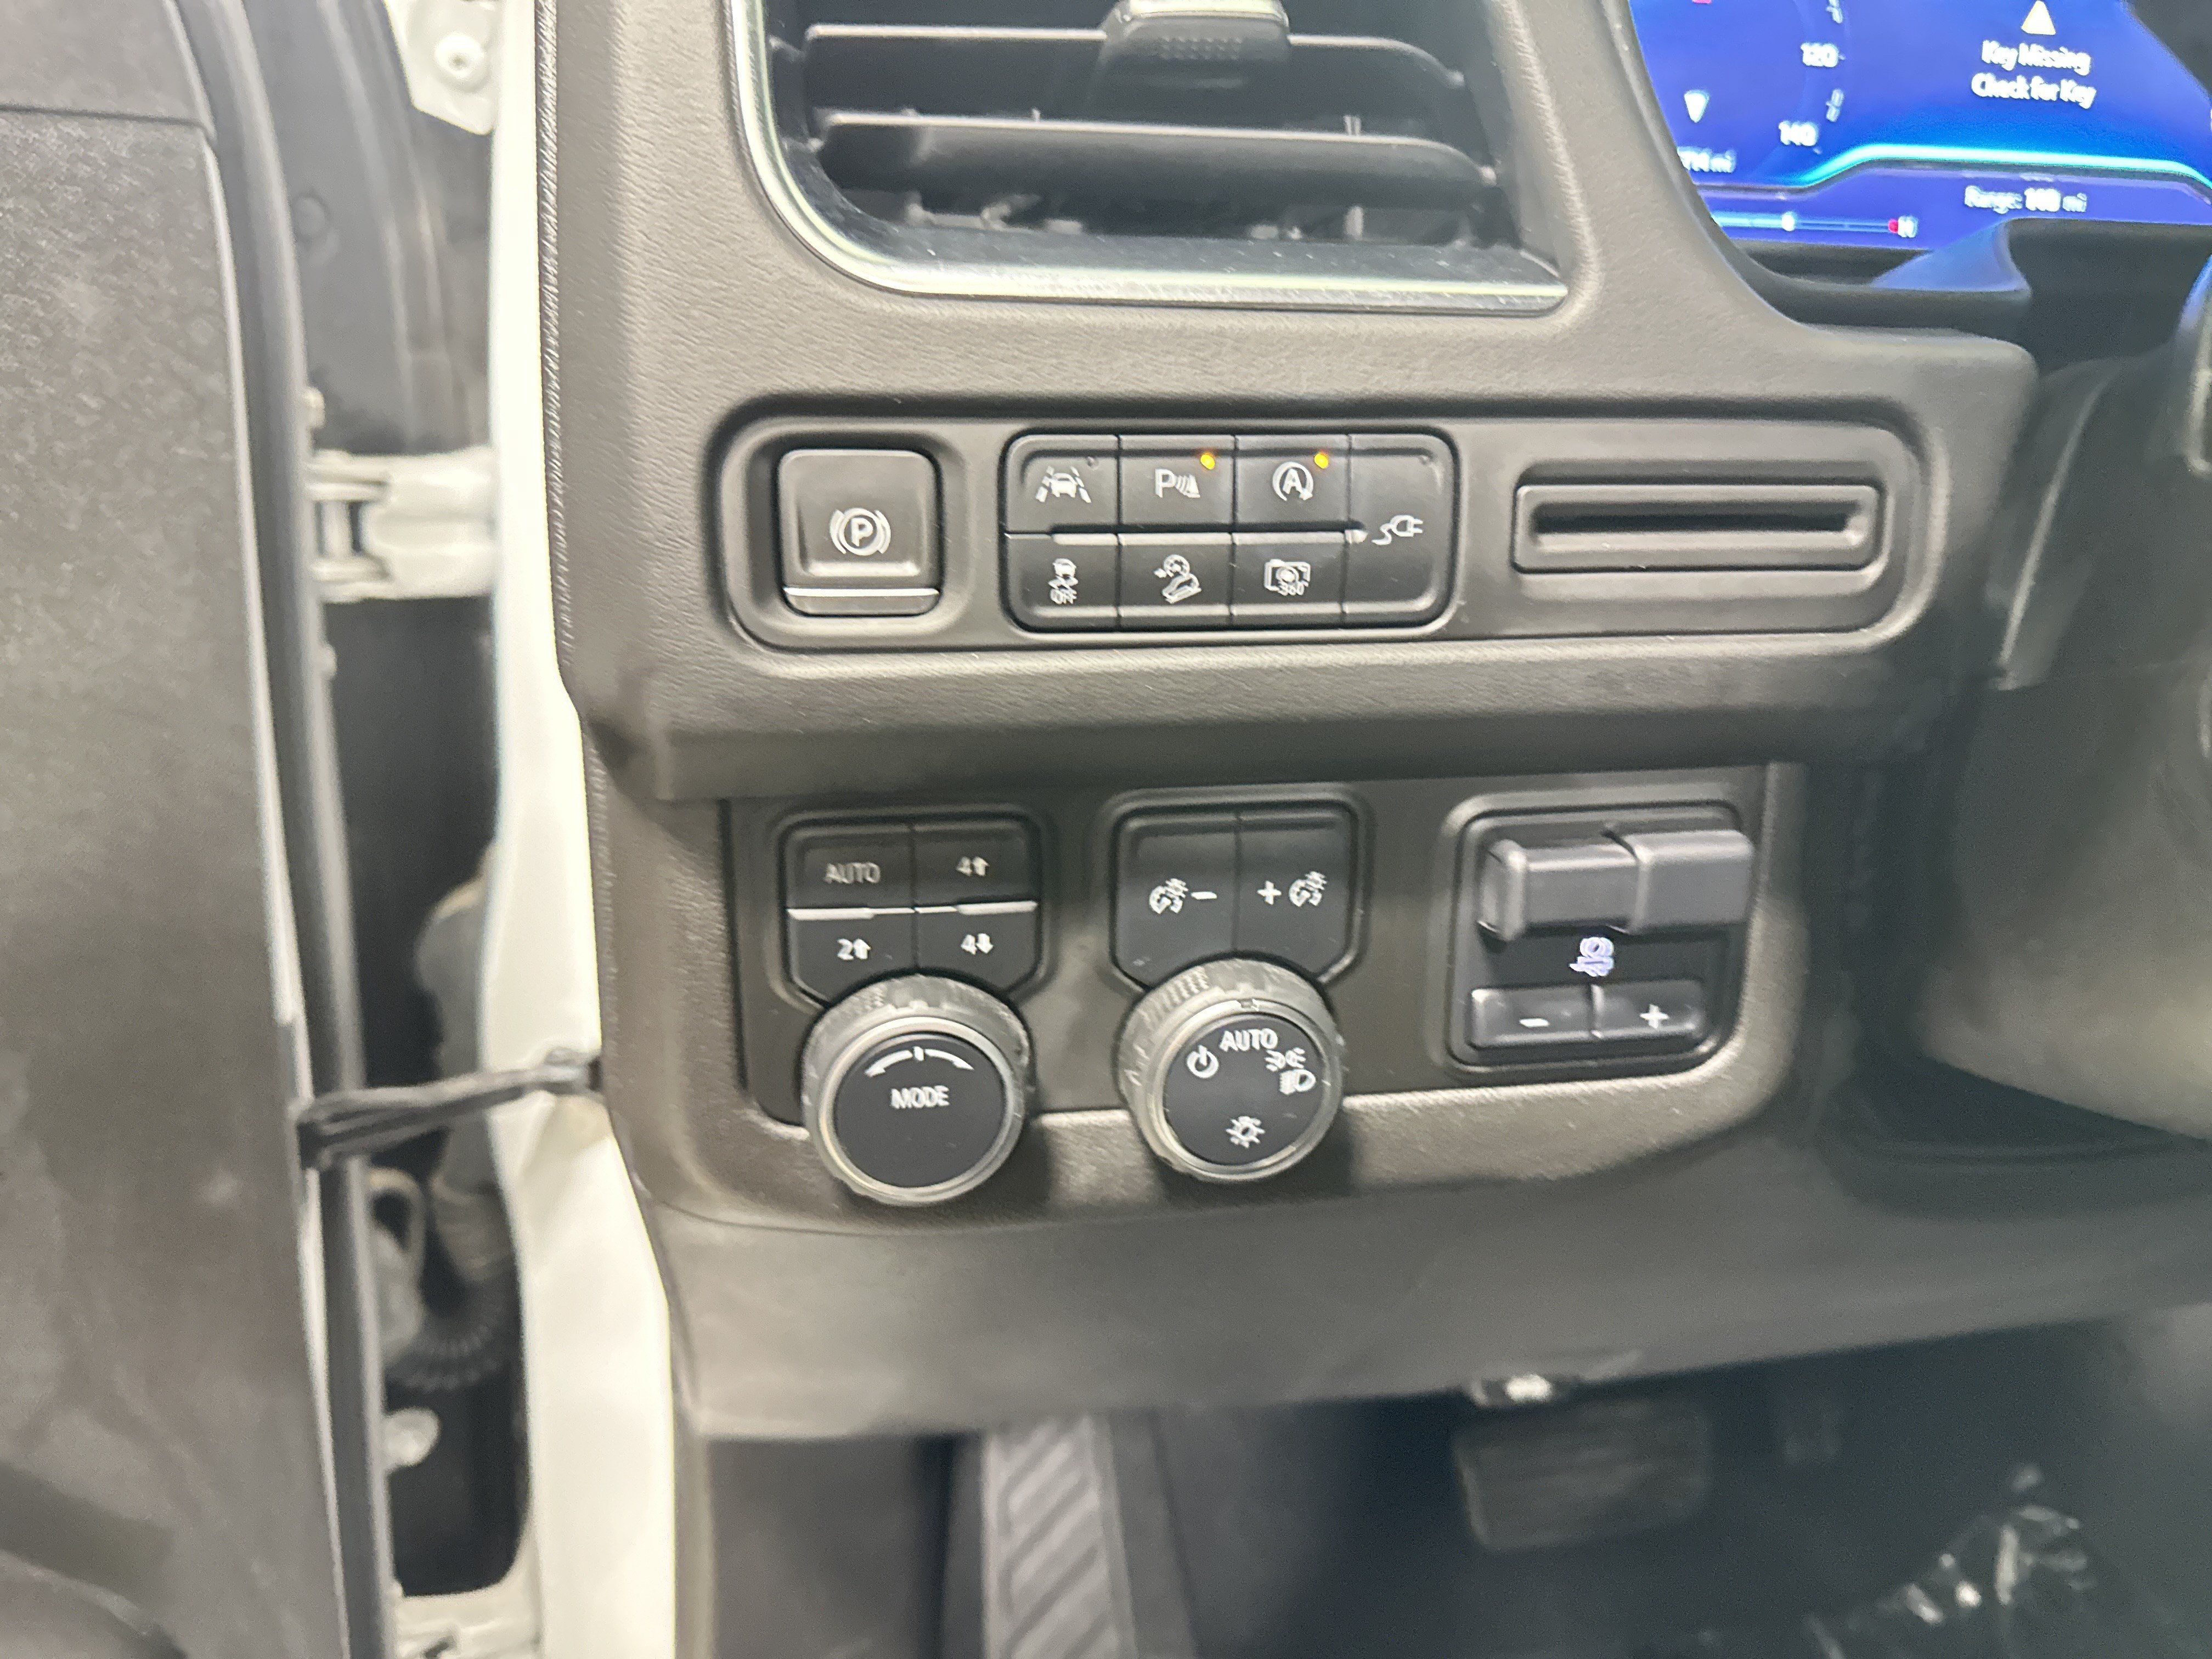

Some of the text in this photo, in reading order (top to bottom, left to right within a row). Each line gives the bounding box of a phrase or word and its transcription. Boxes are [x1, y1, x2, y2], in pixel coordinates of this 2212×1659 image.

[1801, 42, 1838, 67] 120
[1982, 40, 2091, 76] Key Missing
[1971, 72, 2097, 109] Check for Key
[1779, 120, 1819, 146] 140
[825, 861, 881, 884] AUTO
[1219, 1028, 1278, 1052] AUTO
[890, 1085, 950, 1109] MODE
